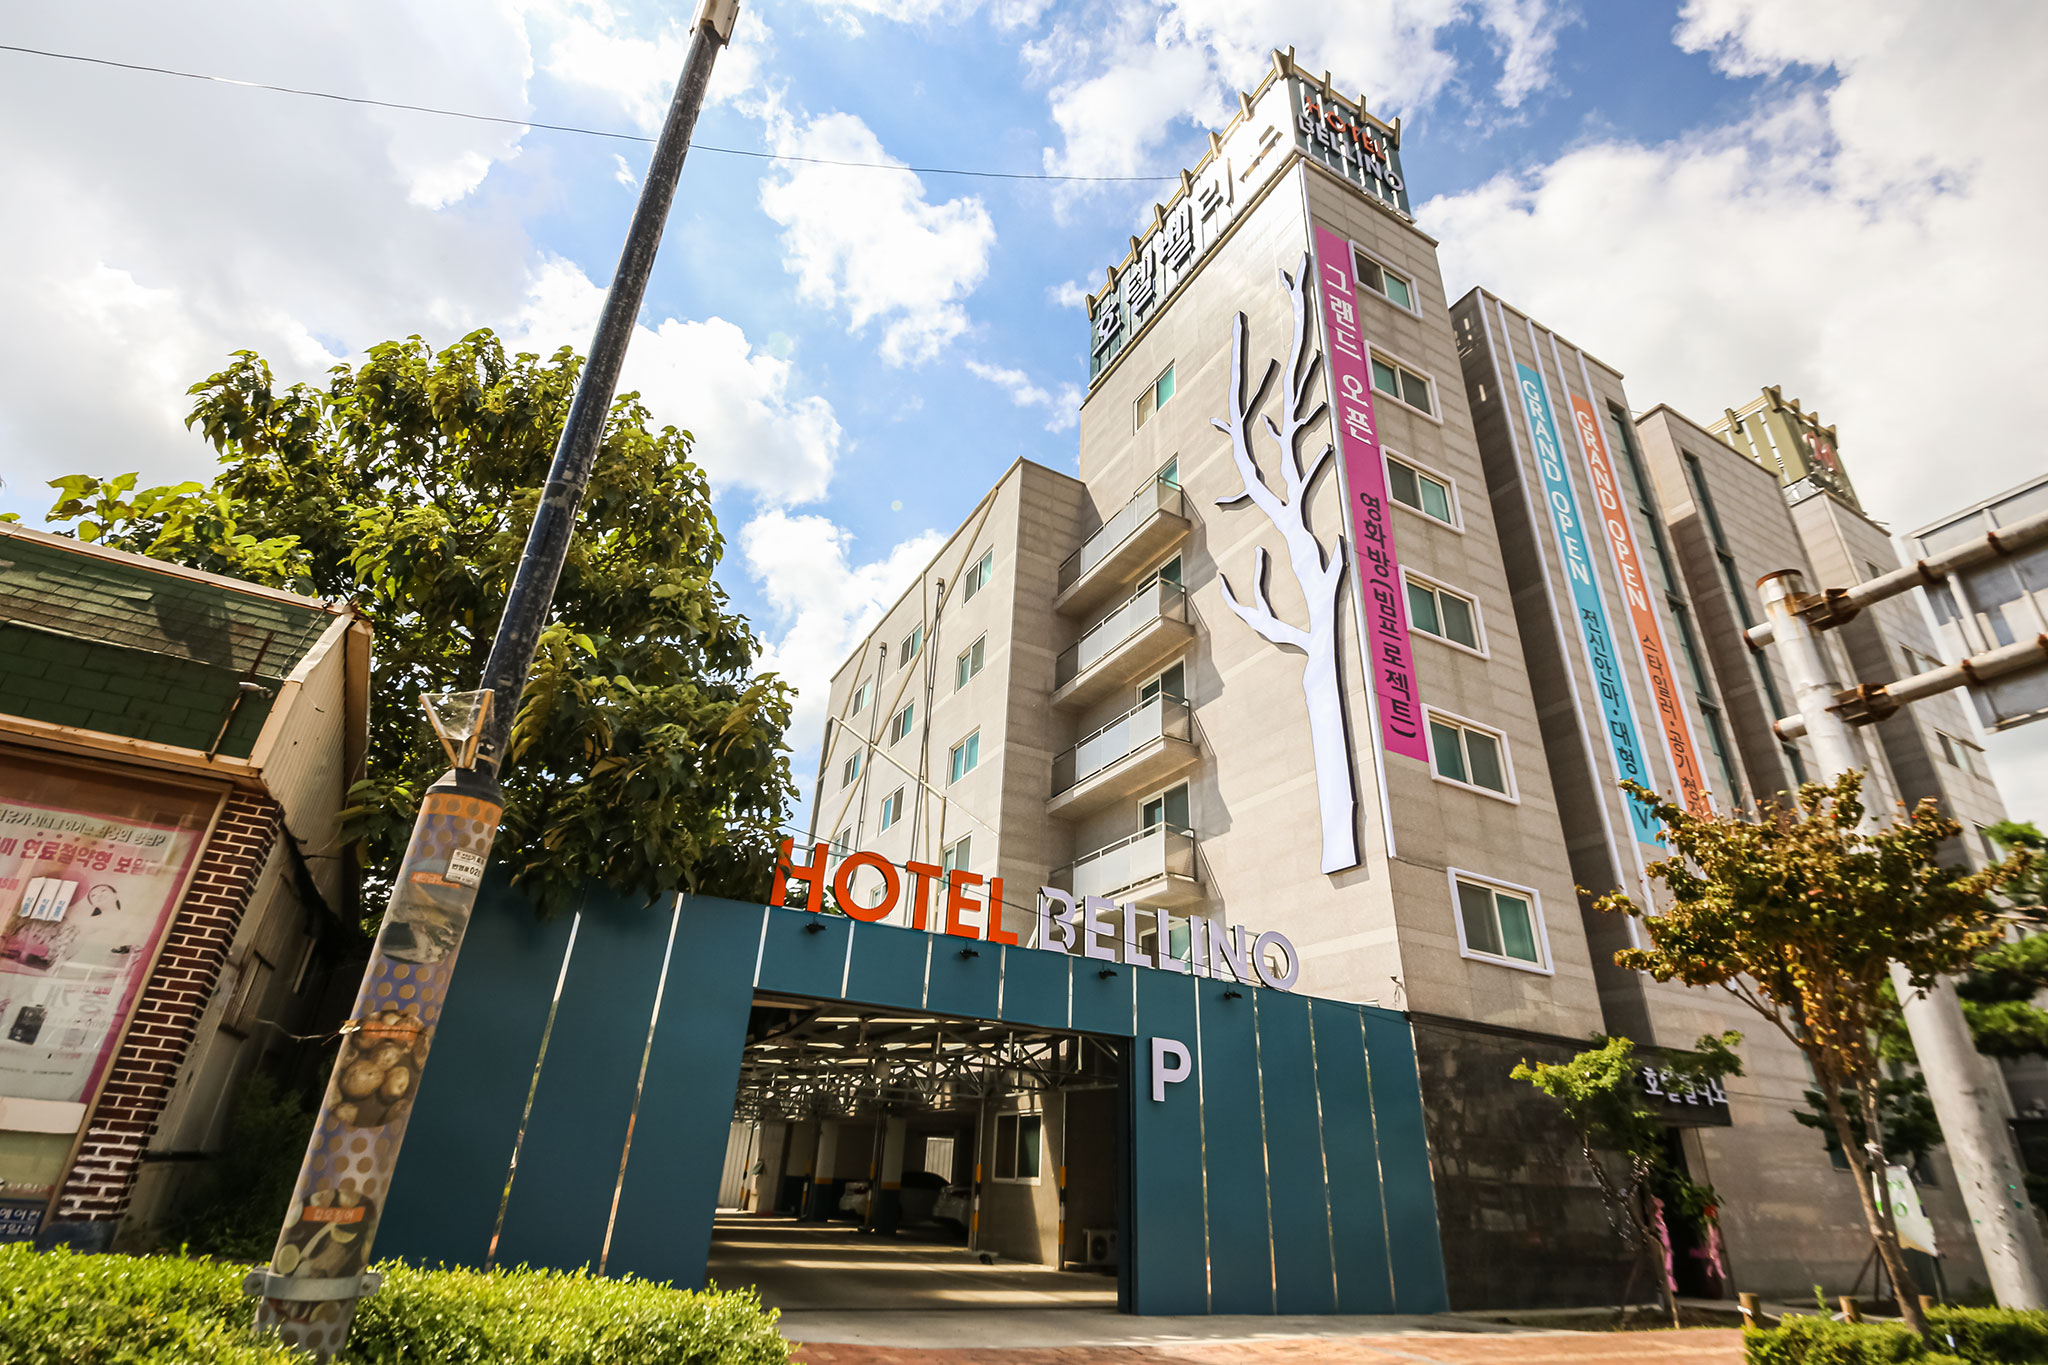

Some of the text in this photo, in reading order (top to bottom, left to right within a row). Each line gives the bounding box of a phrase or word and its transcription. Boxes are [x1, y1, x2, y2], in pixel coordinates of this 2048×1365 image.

[1297, 112, 1404, 191] BELLINO
[1306, 96, 1386, 161] HOTEL
[1326, 264, 1374, 445] 그랜드 오픈
[1522, 380, 1590, 586] GRAND OPEN
[1577, 410, 1647, 612] GRAND OPEN
[20, 838, 113, 871] 연료절약형
[770, 838, 1018, 946] HOTEL
[1036, 886, 1300, 991] BELLINO
[1151, 1036, 1192, 1102] P
